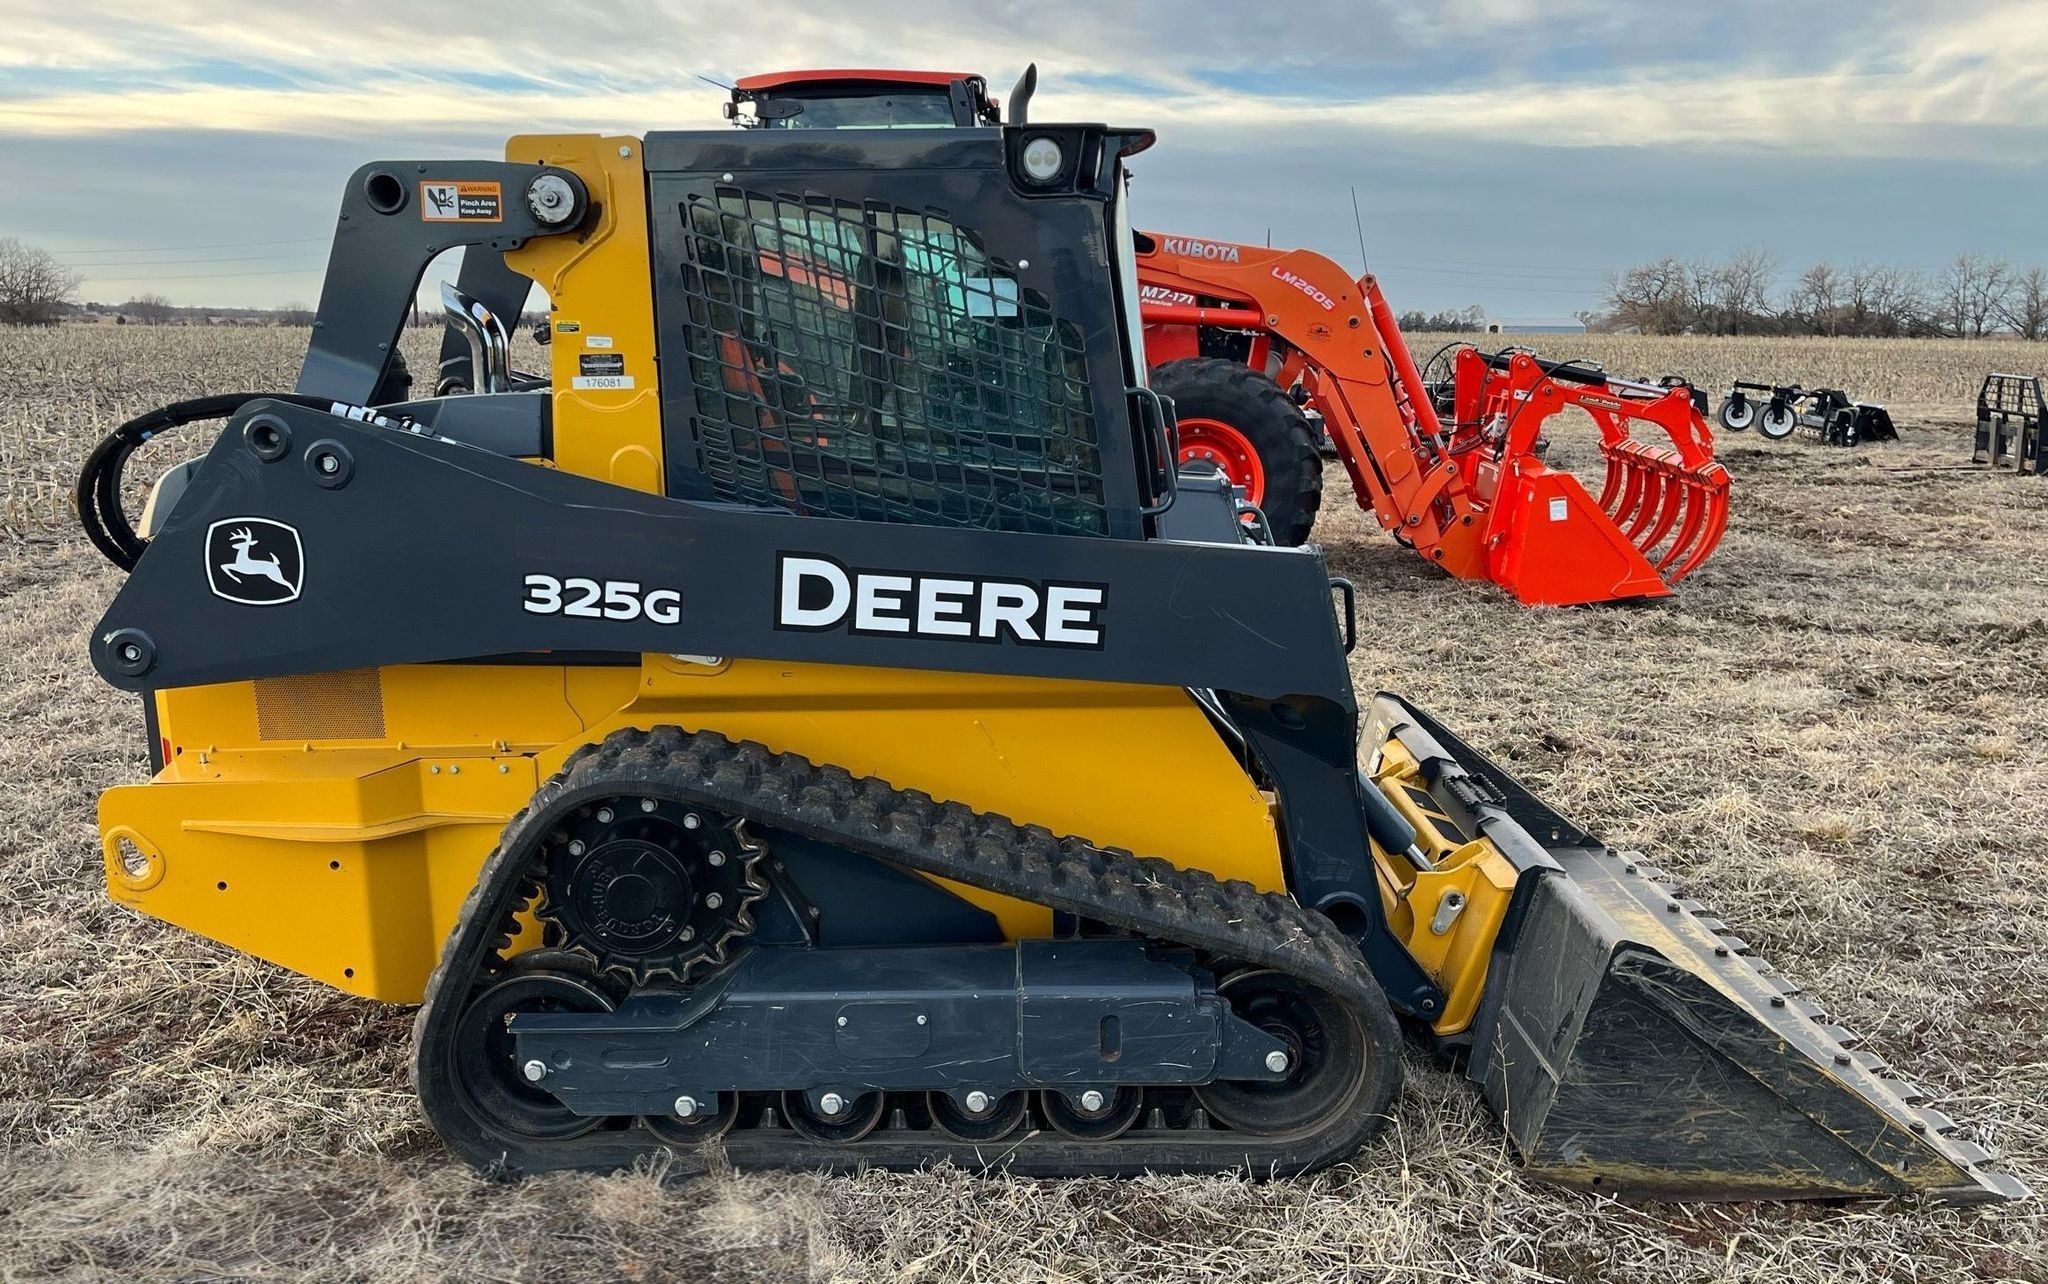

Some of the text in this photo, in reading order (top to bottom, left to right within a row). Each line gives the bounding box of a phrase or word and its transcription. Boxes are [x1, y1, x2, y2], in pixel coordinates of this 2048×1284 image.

[467, 185, 497, 193] WARNING
[460, 199, 497, 207] Pinch Area
[476, 208, 492, 216] Away
[1163, 238, 1240, 263] KUBOTA
[1141, 285, 1195, 304] M7-171
[1271, 266, 1336, 311] LM2605
[586, 378, 621, 388] 176081
[523, 574, 681, 624] 325G
[780, 557, 1103, 644] DEERE
